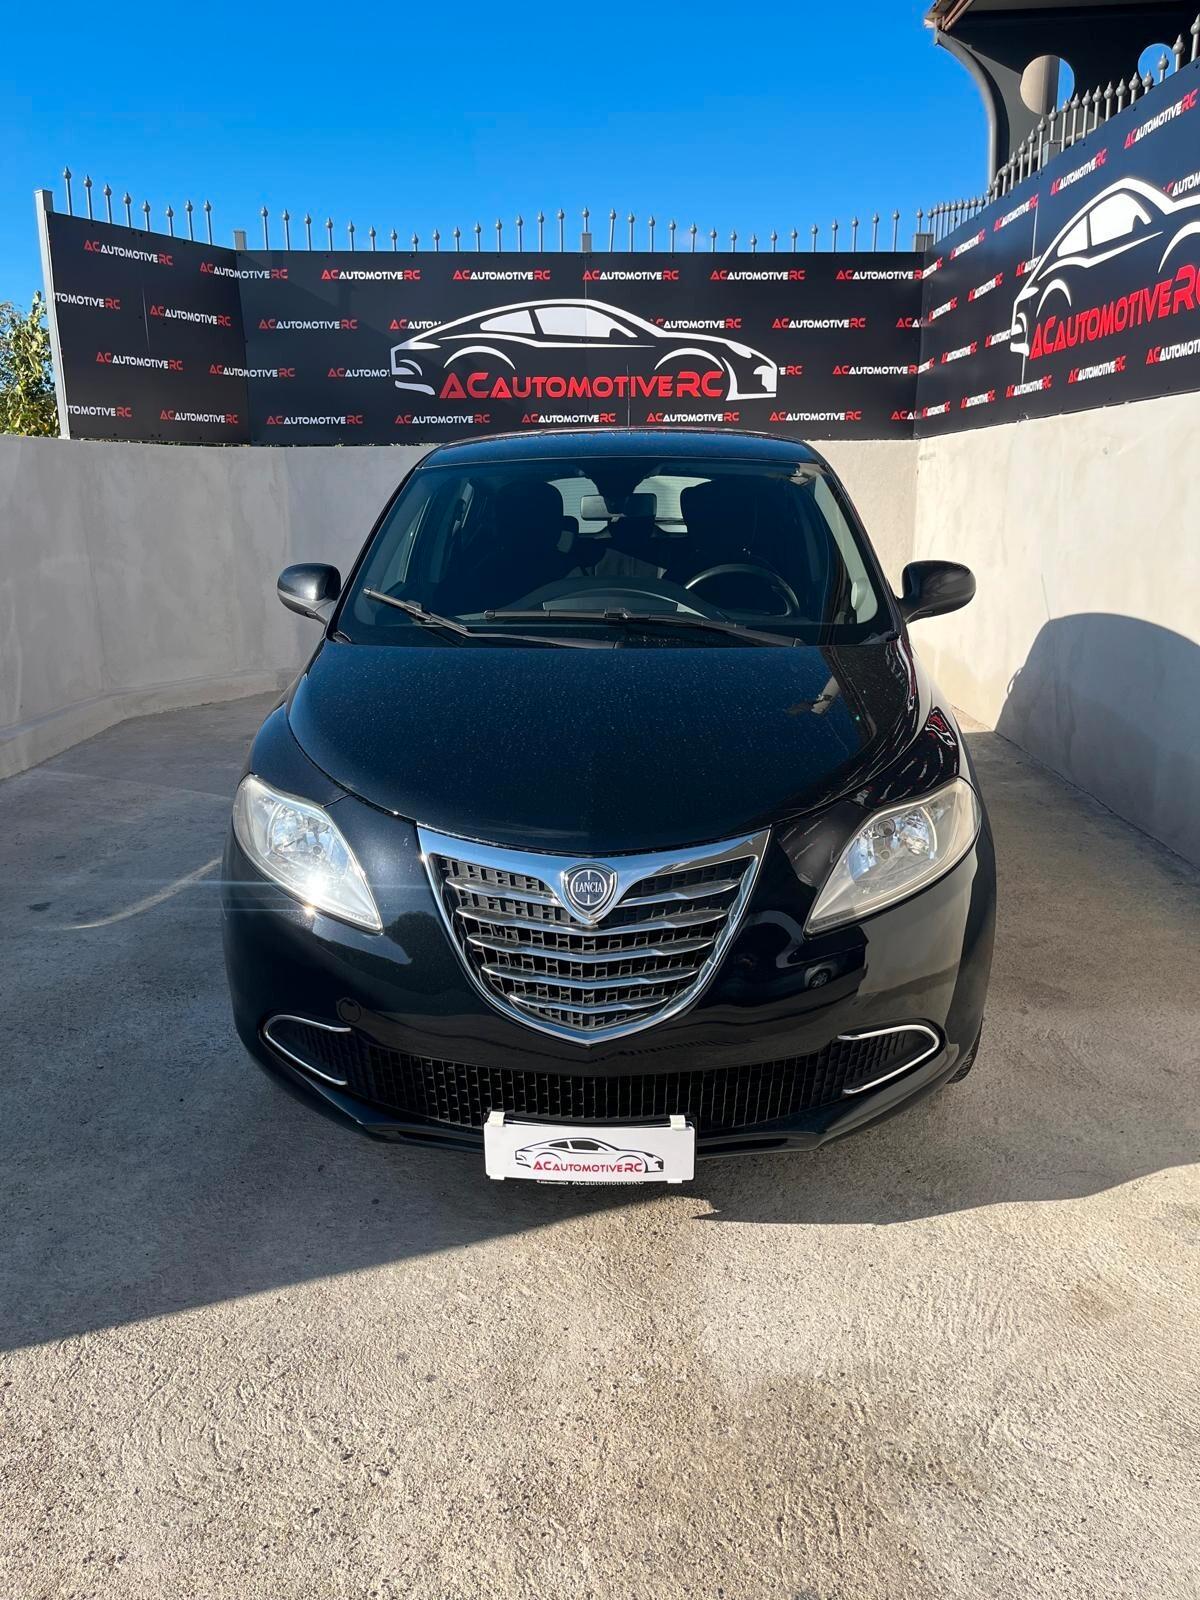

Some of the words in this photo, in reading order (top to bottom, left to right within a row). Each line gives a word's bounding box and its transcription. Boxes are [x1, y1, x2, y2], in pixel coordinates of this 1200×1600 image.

[1124, 88, 1198, 149] ACAUTOMOTIVERC
[84, 240, 174, 265] ACAUTOMOTIVERC
[200, 263, 288, 279] ACAUTOMOTIVERC
[321, 270, 421, 280] ACAUTOMOTIVERC
[453, 270, 550, 280] ACAUTOMOTIVERC
[582, 270, 679, 280] ACAUTOMOTIVERC
[710, 270, 805, 280] ACAUTOMOTIVERC
[150, 305, 231, 326] ACAUTOMOTIVERC
[1029, 264, 1200, 360] ACAUTOMOTIVER
[259, 319, 357, 329] ACAUTOMOTIVERC
[772, 318, 865, 328] ACAUTOMOTIVERC
[96, 352, 183, 370] ACAUTOMOTIVERC
[210, 365, 294, 377] ACAUTOMOTIVERC
[439, 372, 724, 399] ACAUTOMOTIVERC
[67, 405, 132, 417] TOMOTIVERC
[160, 410, 238, 423] ACAUTOMOTIVERC
[647, 412, 739, 422] ACAUTOMOTIVERC
[769, 411, 861, 422] ACAUTOMOTIVERC
[267, 415, 362, 424] ACAUTOMOTIVERC
[395, 414, 490, 424] ACAUTOMOTIVERC
[522, 413, 616, 424] ACAUTOMOTIVERC
[575, 881, 603, 893] LANCIA
[533, 1160, 643, 1173] ACAUTOMOTIVERC
